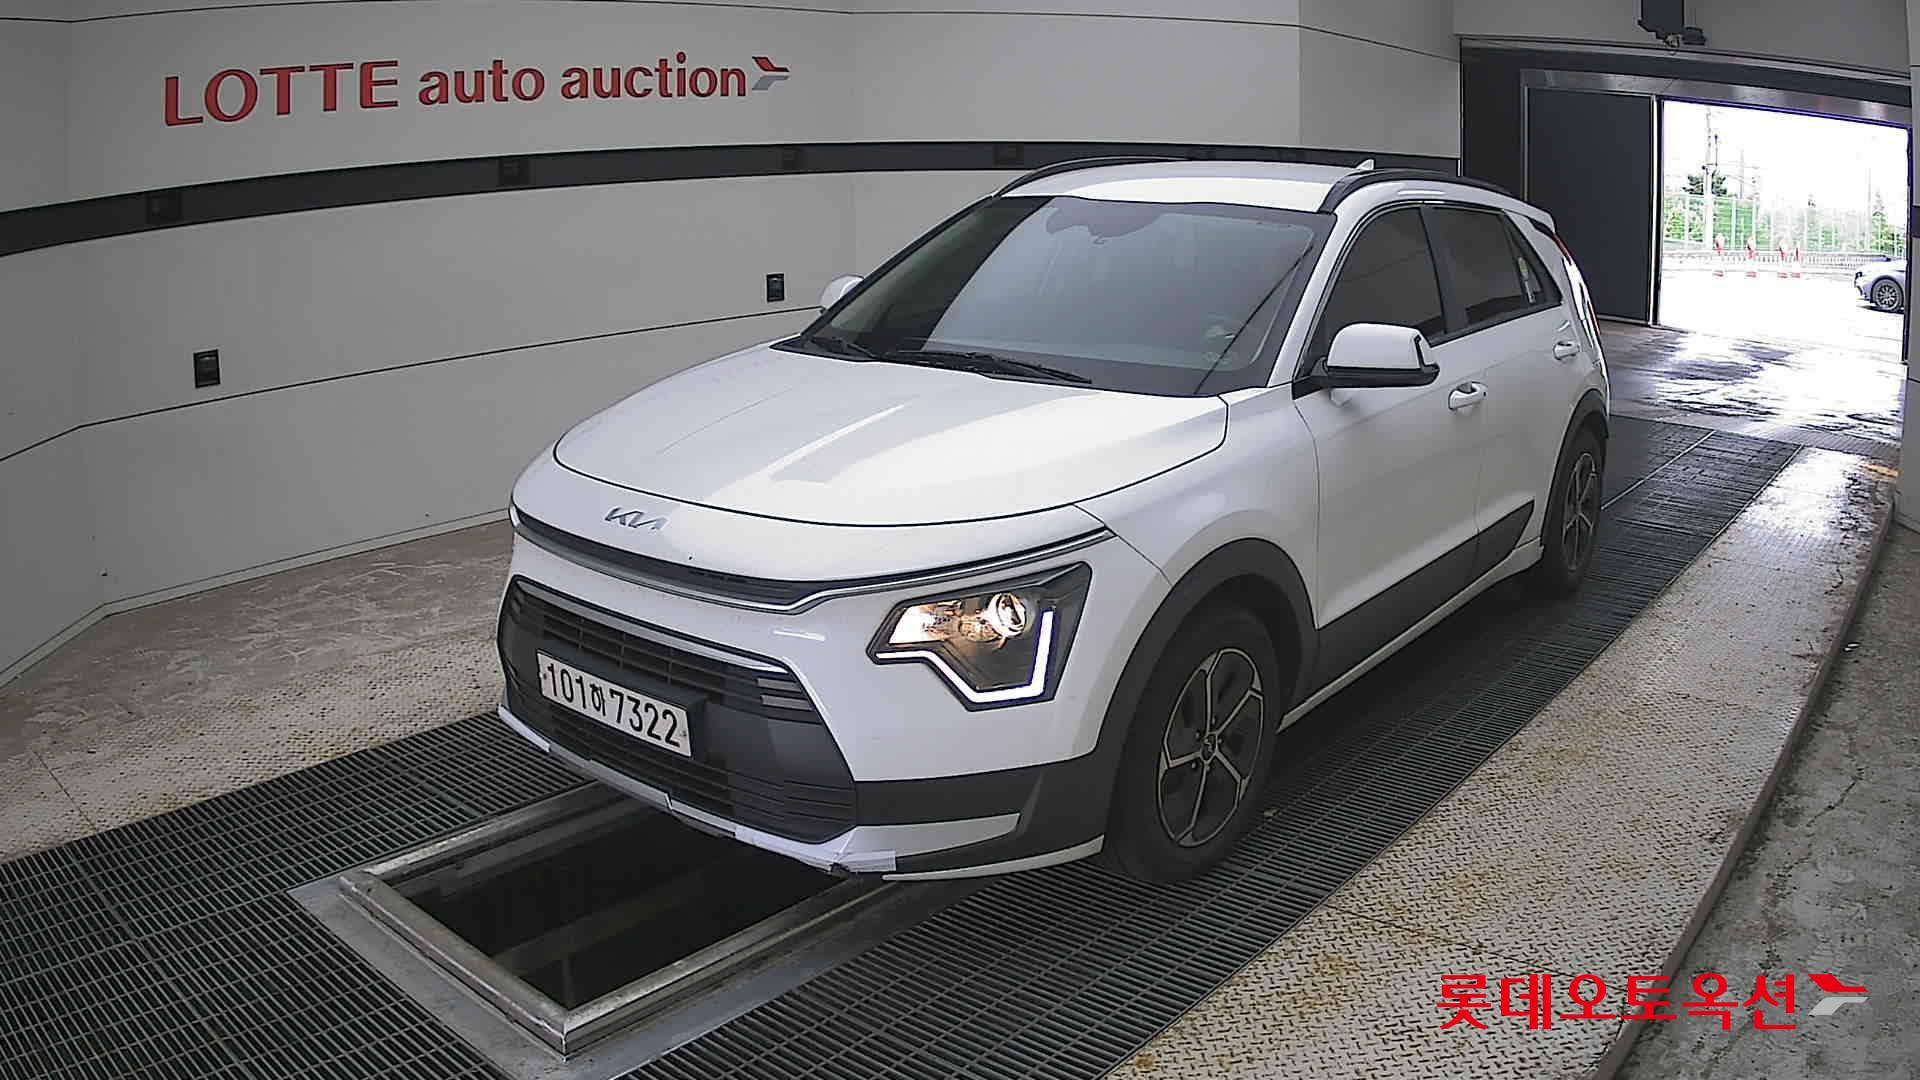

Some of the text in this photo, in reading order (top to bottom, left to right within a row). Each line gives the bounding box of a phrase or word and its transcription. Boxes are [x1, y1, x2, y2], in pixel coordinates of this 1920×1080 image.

[164, 51, 747, 126] LOTTE auto auction
[604, 506, 668, 530] KIA
